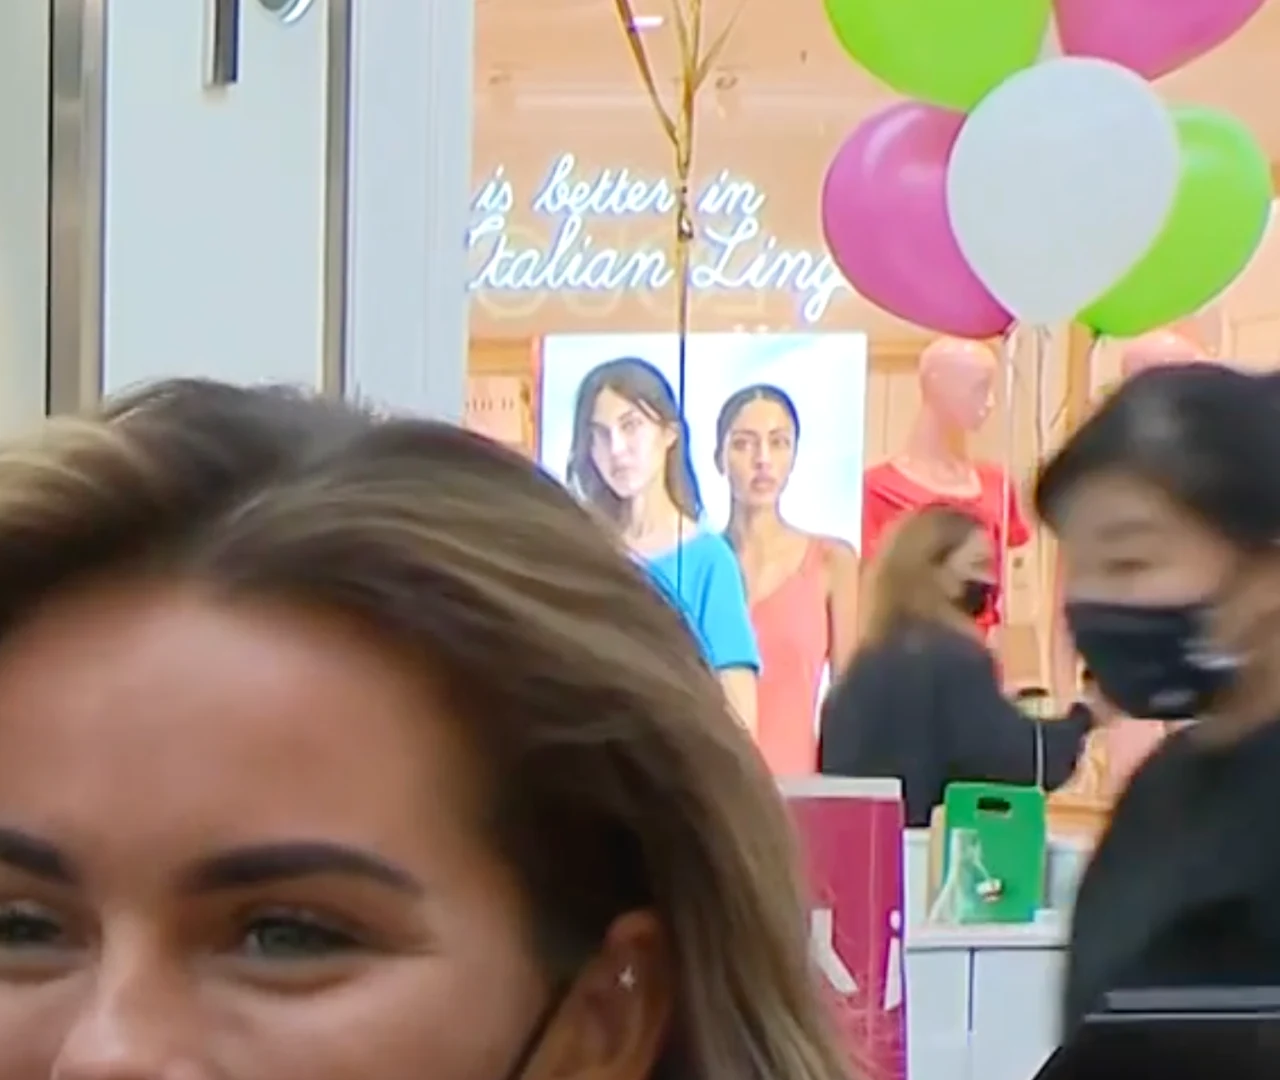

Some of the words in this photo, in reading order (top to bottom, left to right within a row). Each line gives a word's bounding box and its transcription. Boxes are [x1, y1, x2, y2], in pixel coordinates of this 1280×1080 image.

[474, 164, 513, 212] is
[532, 152, 676, 213] better
[697, 170, 765, 214] in
[468, 214, 674, 289] Italian
[690, 215, 850, 322] Ling
